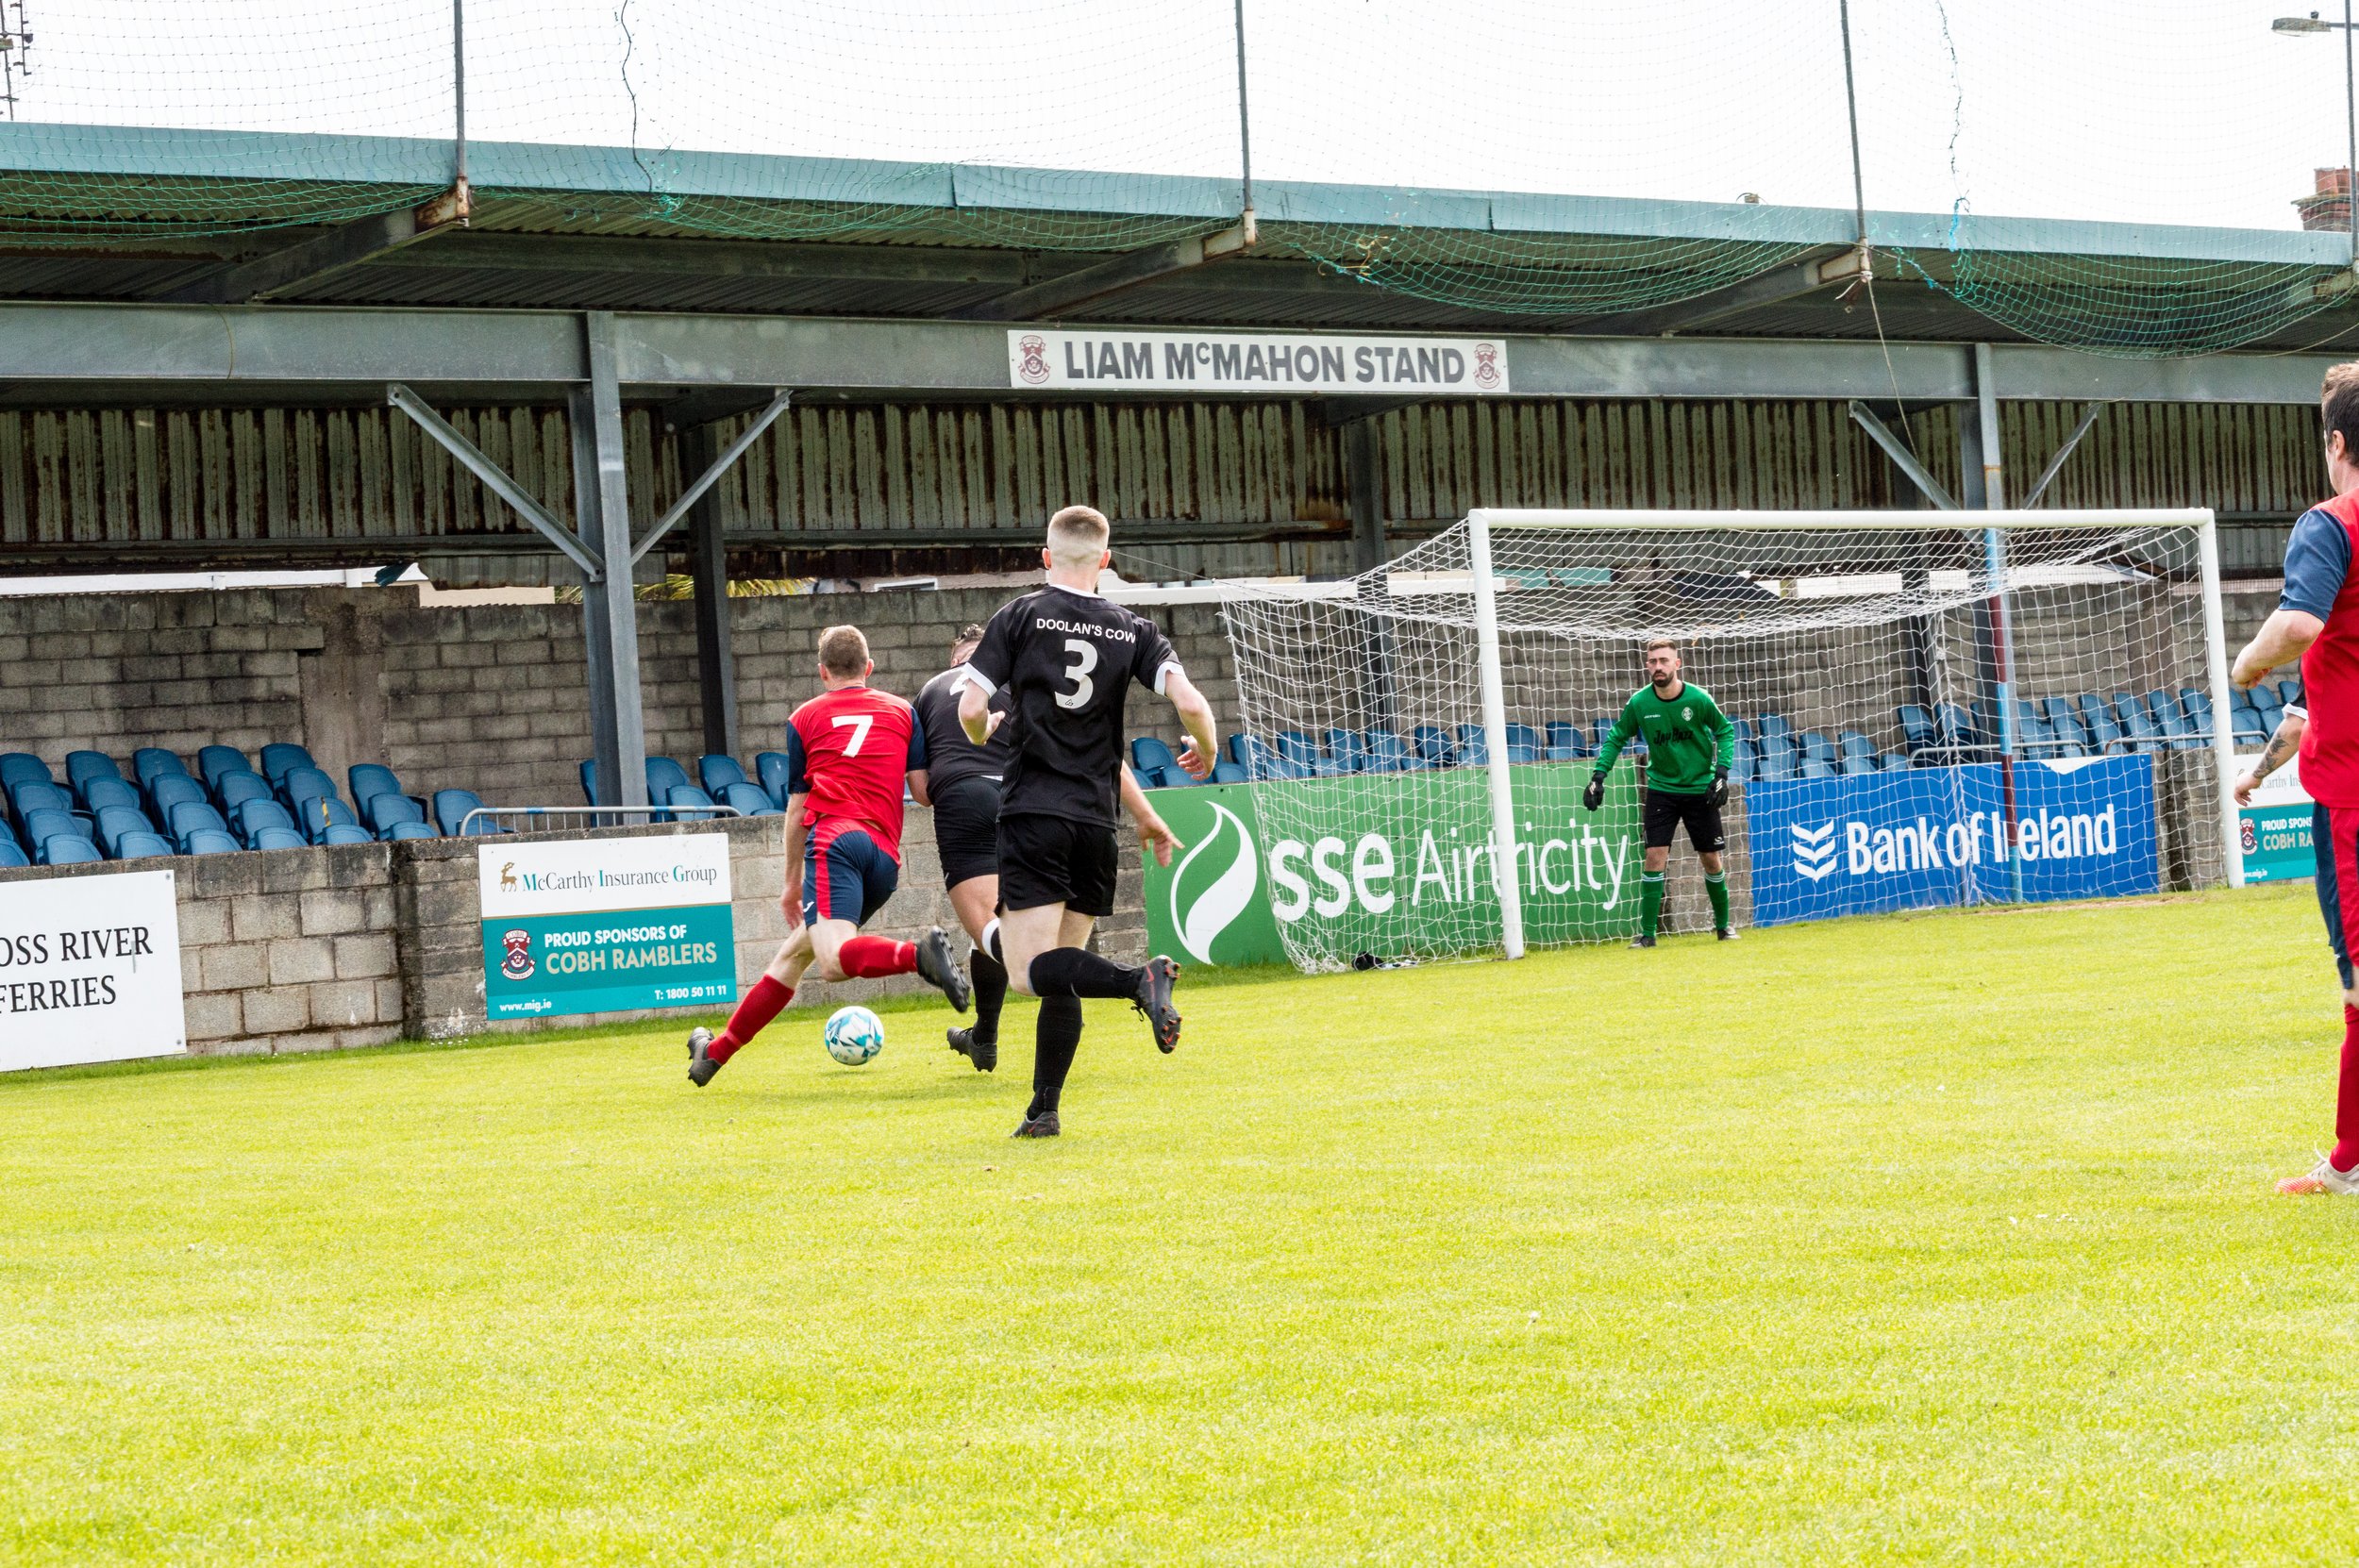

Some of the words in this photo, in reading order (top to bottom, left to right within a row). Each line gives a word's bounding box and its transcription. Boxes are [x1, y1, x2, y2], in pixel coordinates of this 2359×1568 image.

[1064, 341, 1154, 379] LIAM
[1164, 342, 1346, 382] McMAHON
[1354, 346, 1464, 383] STAND
[1036, 618, 1102, 637] DOOLAN'S
[1054, 639, 1098, 709] 3
[831, 714, 874, 759] 7
[2260, 775, 2287, 791] Carthy
[2261, 818, 2287, 831] PROUD
[2288, 816, 2312, 829] SPONS
[1847, 816, 1944, 876] Bank
[1946, 811, 1985, 867] of
[2263, 833, 2296, 851] COBH
[523, 870, 594, 892] McCarthy
[599, 869, 669, 887] Insurance
[673, 865, 717, 886] Group
[1269, 833, 1395, 921] sse
[59, 926, 153, 961] RIVER
[544, 930, 592, 947] PROUD
[594, 926, 666, 945] SPONSORS
[669, 924, 687, 940] OF
[545, 949, 606, 975] COBH
[612, 942, 717, 970] RAMBLERS
[499, 999, 552, 1012] www.mig.ie
[655, 990, 663, 1000] T:
[666, 988, 689, 999] 1800
[691, 987, 703, 997] 50
[705, 986, 715, 996] 11
[717, 985, 727, 995] 11
